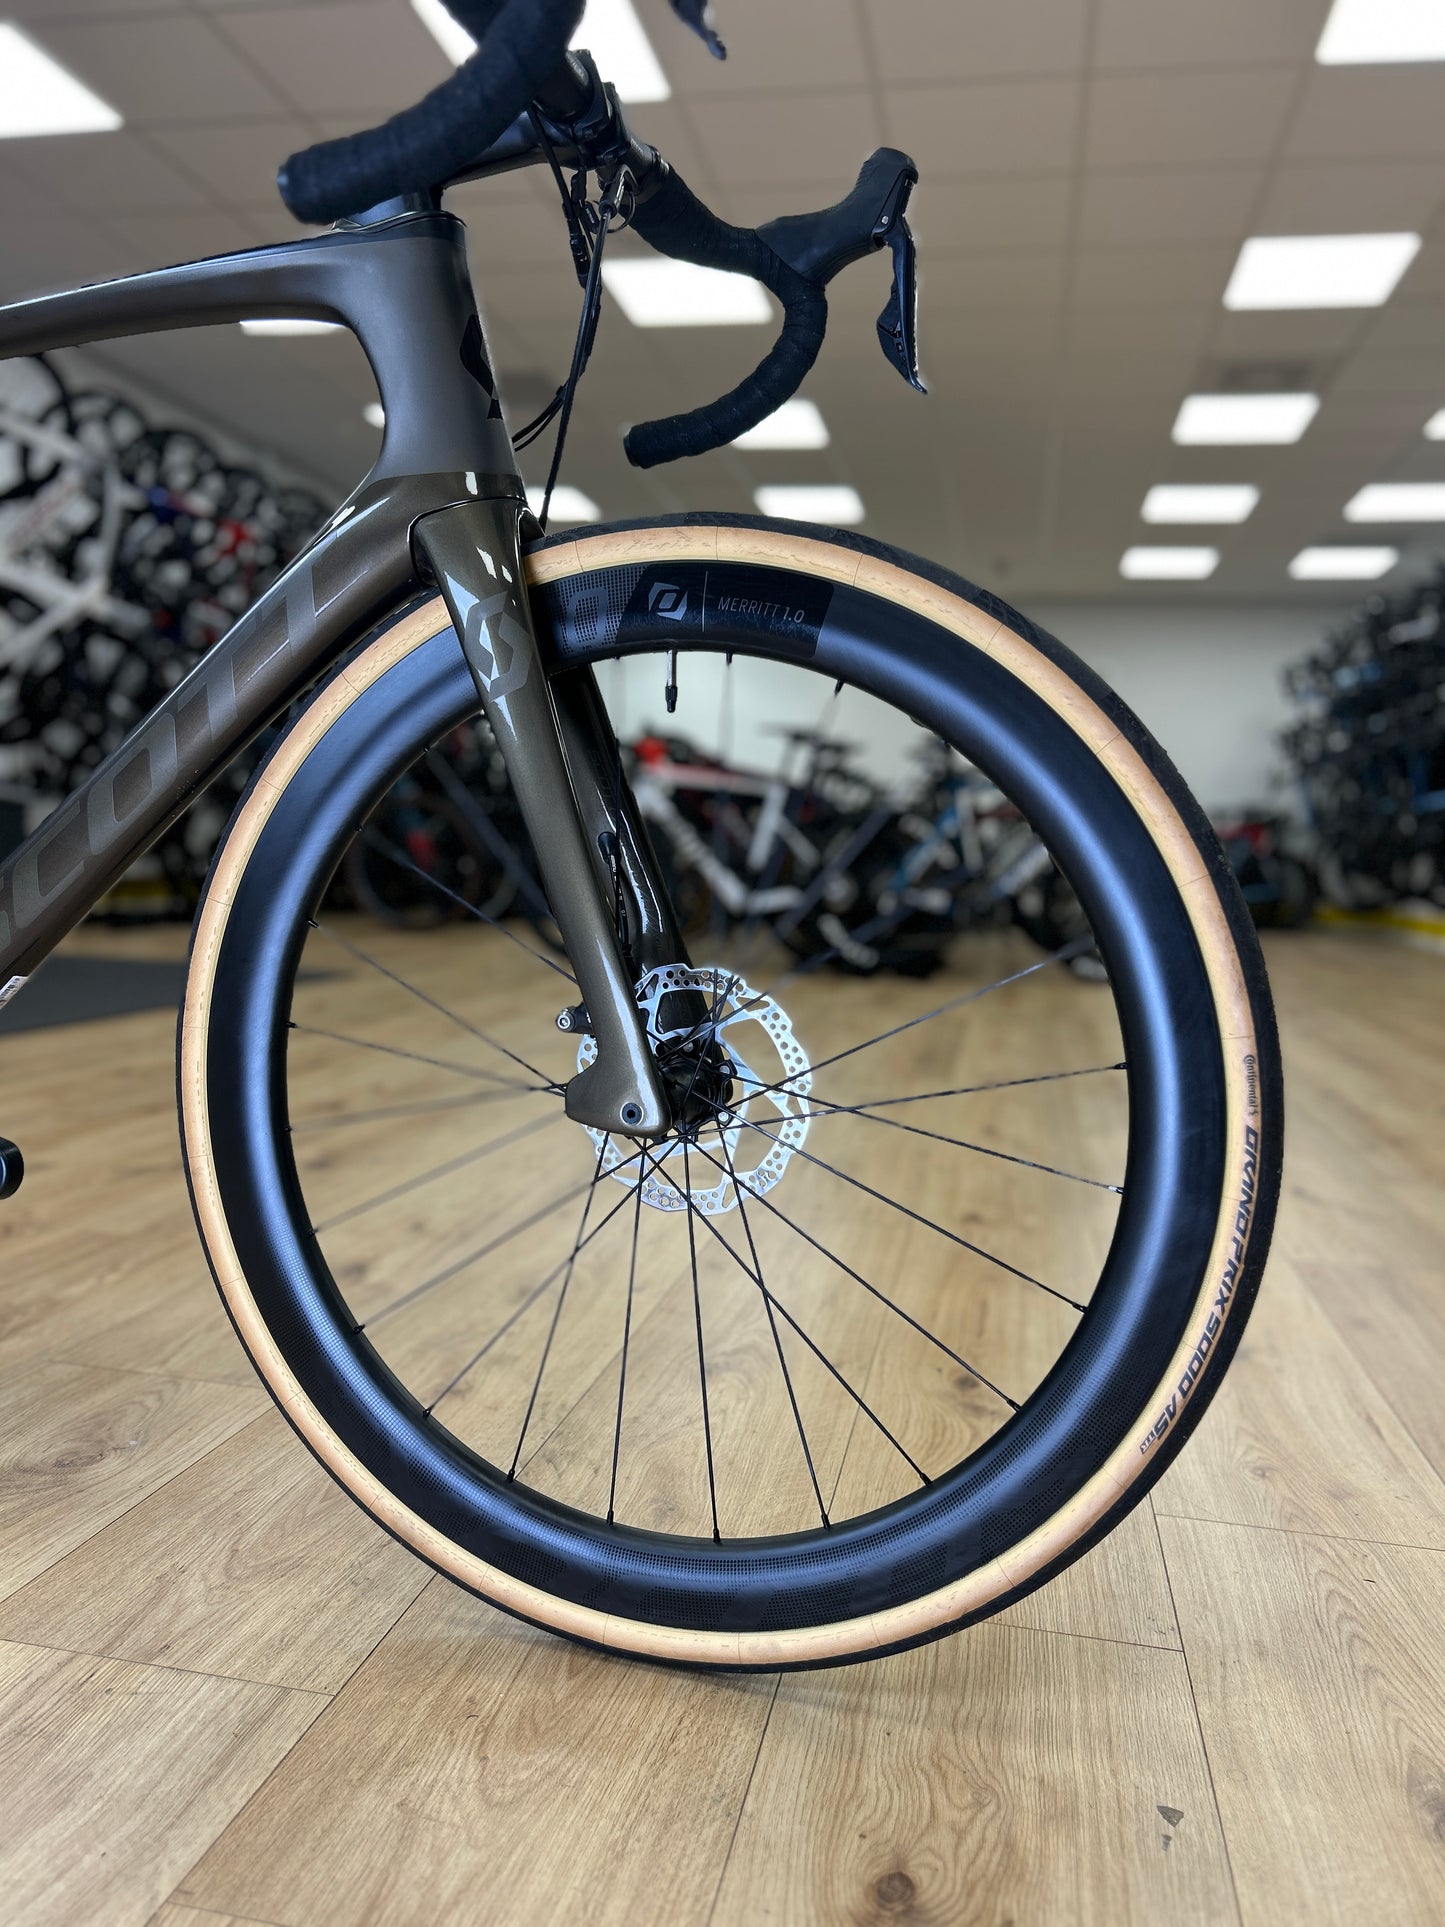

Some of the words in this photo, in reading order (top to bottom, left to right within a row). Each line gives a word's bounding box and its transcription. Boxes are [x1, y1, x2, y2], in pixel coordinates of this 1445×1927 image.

[717, 595, 780, 617] MERRITT
[781, 605, 806, 623] 1.0
[0, 527, 339, 950] COTT
[1243, 1054, 1258, 1108] Continental
[1235, 1124, 1259, 1239] GRAND
[1215, 1237, 1244, 1317] PRIX
[1177, 1311, 1221, 1399] 5000
